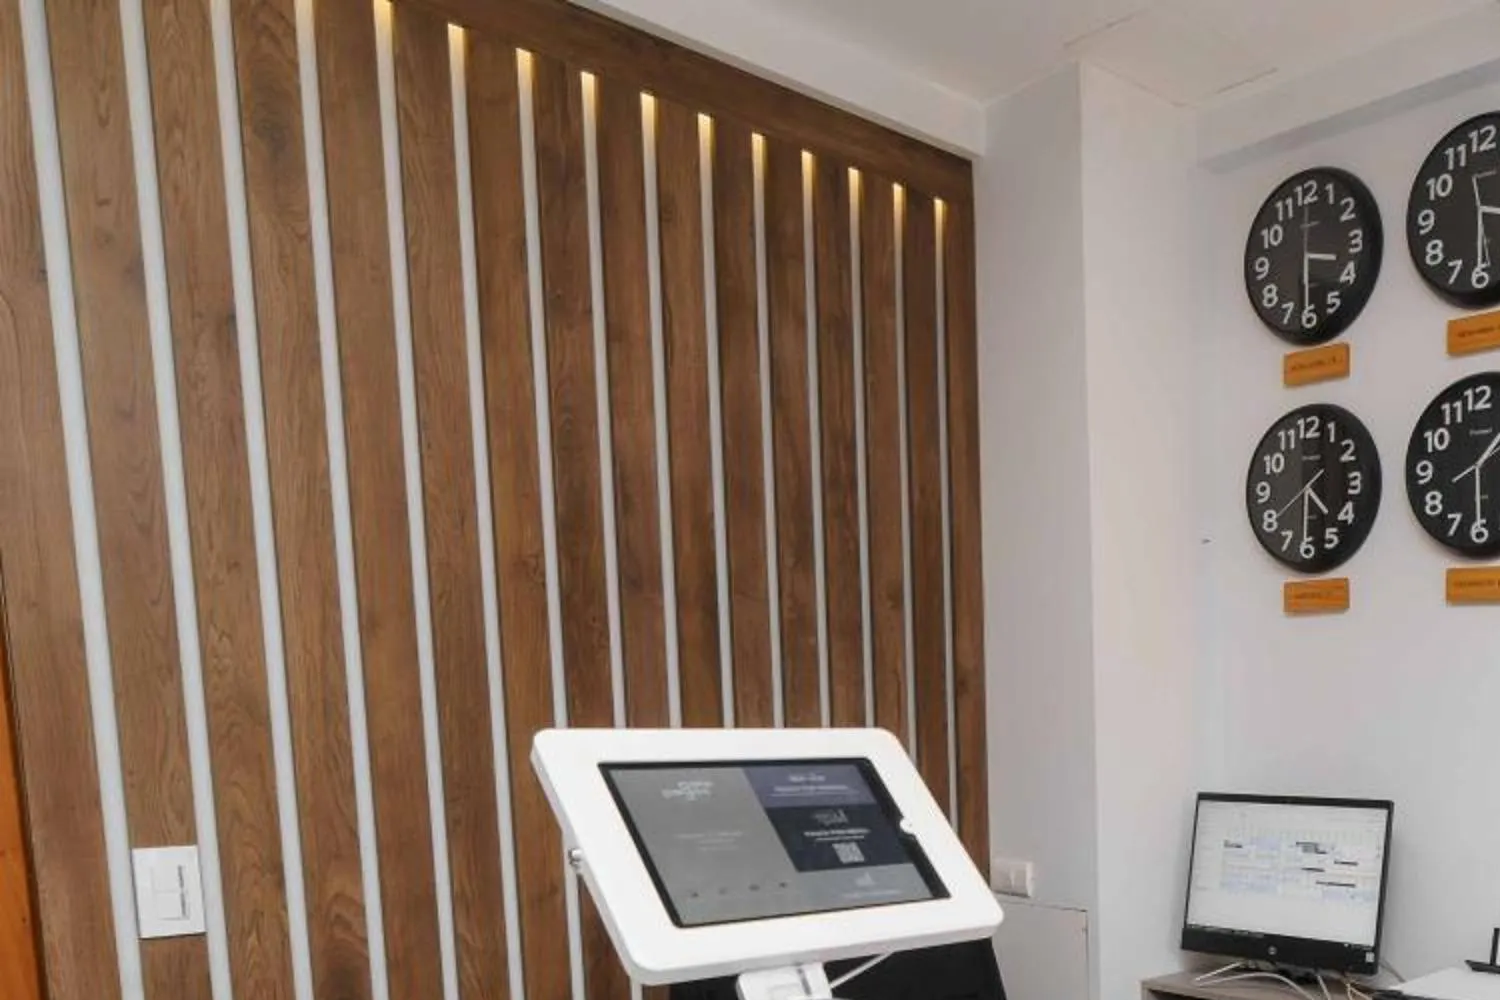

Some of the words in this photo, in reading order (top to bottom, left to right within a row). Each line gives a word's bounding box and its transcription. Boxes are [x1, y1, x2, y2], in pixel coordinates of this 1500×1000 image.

[1468, 124, 1497, 153] 12
[1445, 143, 1467, 170] 11
[1294, 180, 1318, 206] 12
[1325, 183, 1336, 205] 1
[1426, 173, 1453, 200] 10
[1275, 198, 1294, 221] 11
[1339, 197, 1356, 222] 2
[1417, 208, 1435, 235] 9
[1260, 224, 1283, 249] 10
[1348, 229, 1363, 253] 3
[1425, 239, 1444, 266] 8
[1255, 257, 1270, 280] 9
[1339, 261, 1356, 284] 4
[1448, 259, 1463, 285] 7
[1471, 263, 1489, 289] 6
[1262, 284, 1278, 308] 8
[1326, 291, 1341, 313] 5
[1281, 302, 1294, 324] 7
[1301, 304, 1317, 328] 6
[1463, 385, 1492, 412] 12
[1441, 401, 1463, 424] 11
[1297, 415, 1321, 439] 12
[1327, 421, 1336, 443] 1
[1278, 429, 1296, 450] 11
[1339, 439, 1357, 462] 2
[1423, 427, 1450, 452] 10
[1263, 452, 1285, 475] 10
[1415, 459, 1434, 485] 9
[1256, 481, 1271, 504] 9
[1347, 471, 1362, 495] 3
[1337, 501, 1355, 524] 4
[1424, 491, 1443, 516] 8
[1262, 509, 1278, 532] 8
[1447, 513, 1463, 537] 7
[1470, 518, 1489, 543] 6
[1281, 530, 1293, 552] 7
[1300, 537, 1315, 559] 6
[1324, 527, 1339, 549] 5
